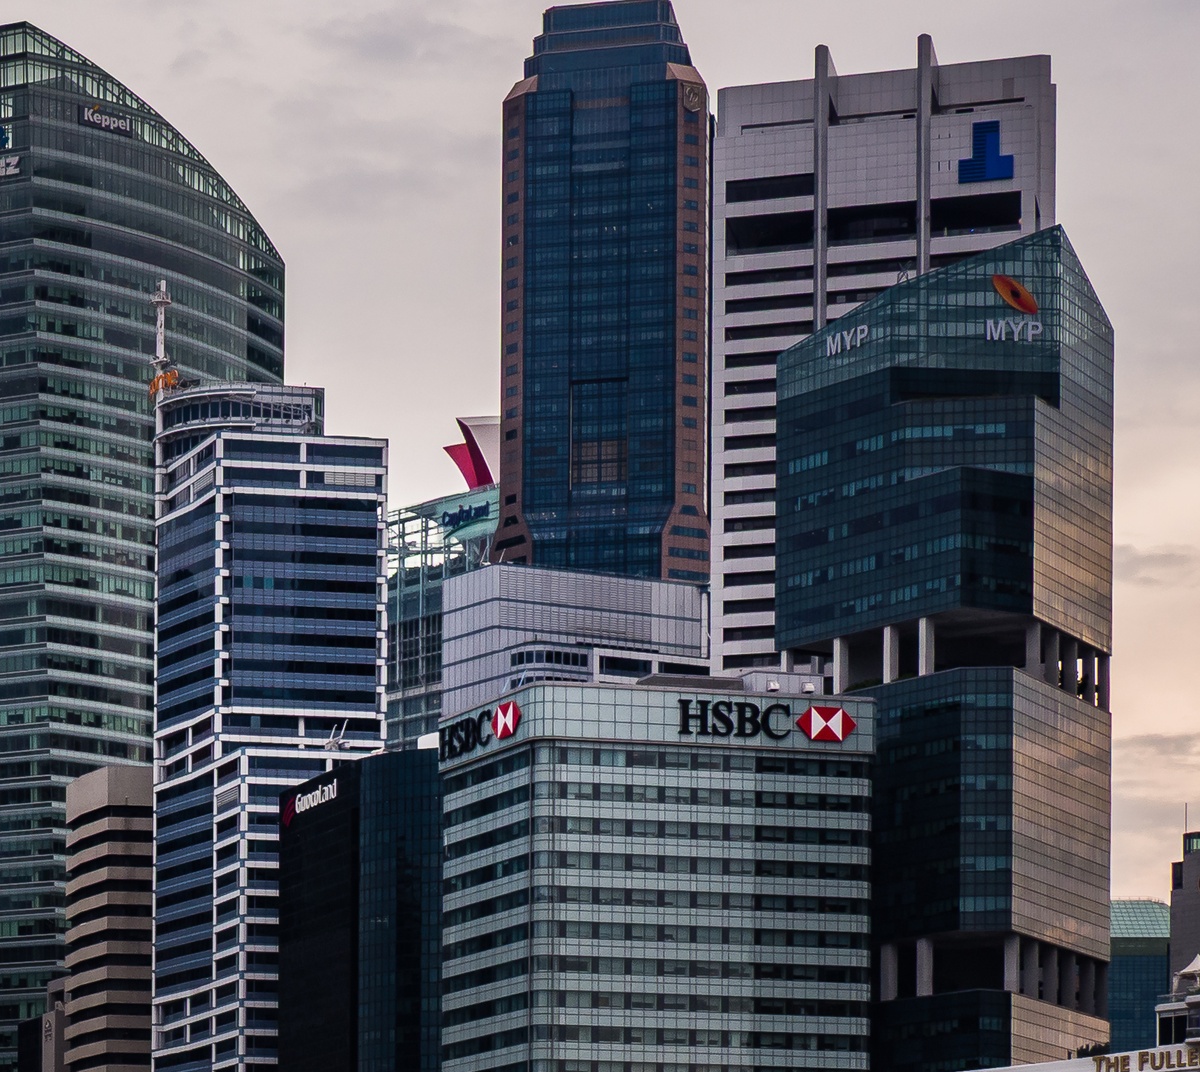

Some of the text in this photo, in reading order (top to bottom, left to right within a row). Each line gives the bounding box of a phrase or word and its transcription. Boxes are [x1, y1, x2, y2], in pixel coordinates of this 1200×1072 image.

[84, 107, 130, 132] Keppel
[826, 324, 869, 357] MYP
[985, 319, 1044, 342] MYP
[678, 699, 792, 740] HSBC
[438, 708, 493, 763] HSBC
[1138, 1048, 1200, 1071] FULLE
